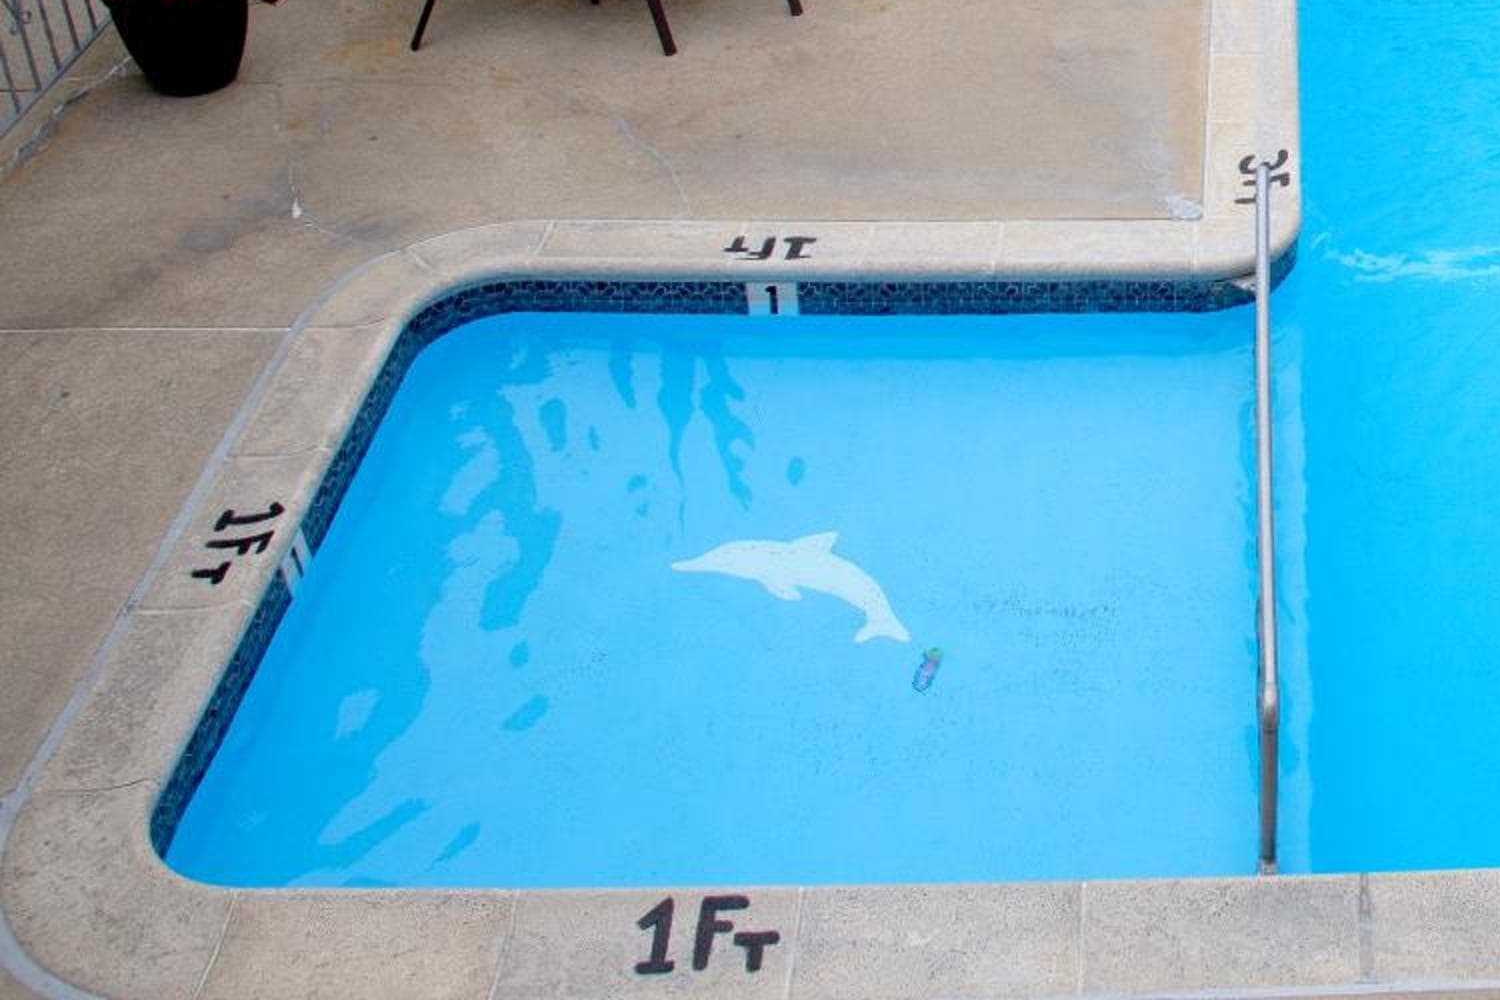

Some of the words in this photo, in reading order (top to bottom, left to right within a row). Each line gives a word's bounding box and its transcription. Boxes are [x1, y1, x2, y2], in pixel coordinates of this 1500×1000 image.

[722, 234, 818, 262] 1FT
[765, 285, 780, 315] 1
[191, 501, 286, 586] 1FT
